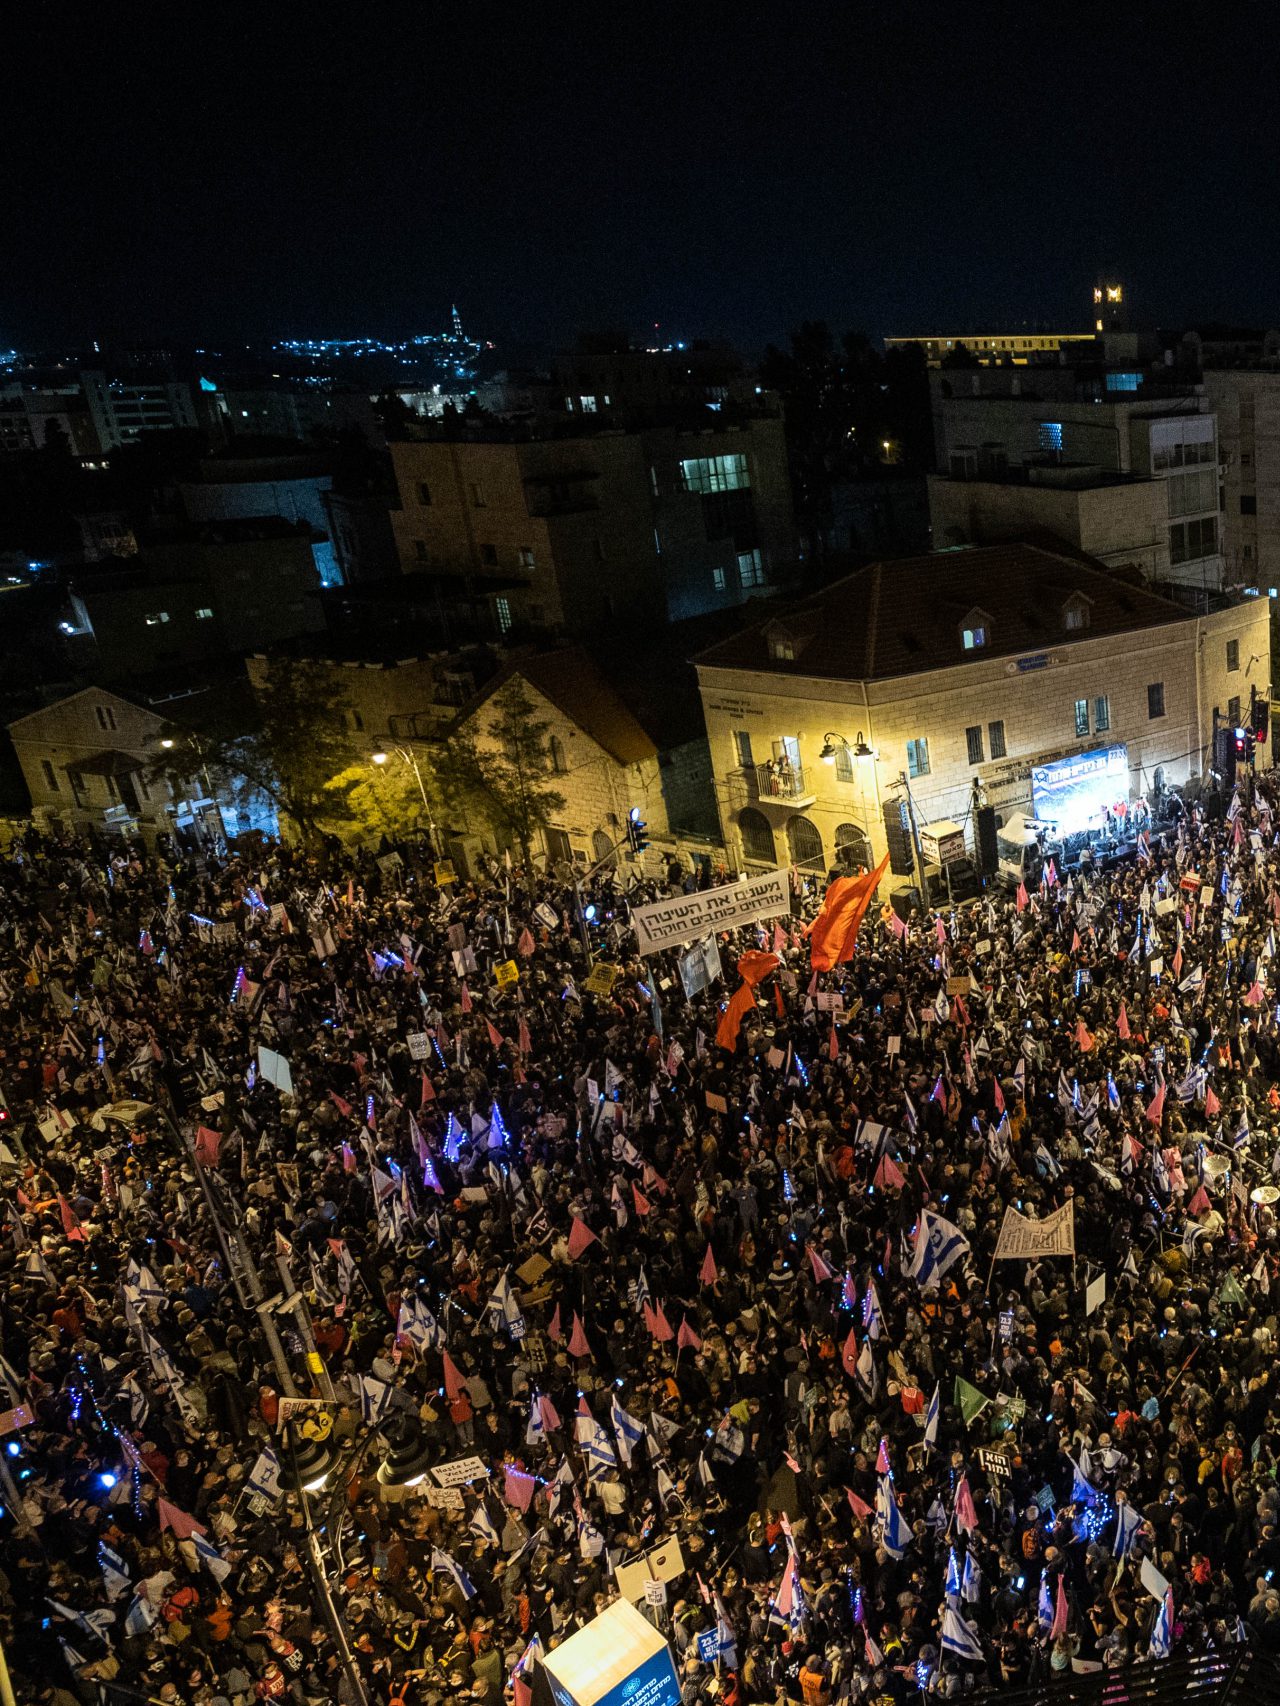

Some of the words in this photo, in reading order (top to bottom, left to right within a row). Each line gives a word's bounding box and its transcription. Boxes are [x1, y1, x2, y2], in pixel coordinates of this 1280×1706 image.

[734, 881, 781, 901] משנים
[707, 895, 731, 909] את
[740, 893, 784, 912] אזרחים
[645, 903, 702, 925] השיטה
[691, 907, 736, 926] כותבים
[651, 920, 688, 937] חוקה
[985, 1452, 1006, 1466] הוא
[435, 1464, 461, 1474] Hasta
[985, 1462, 1010, 1477] גמור
[445, 1472, 478, 1484] Siempre
